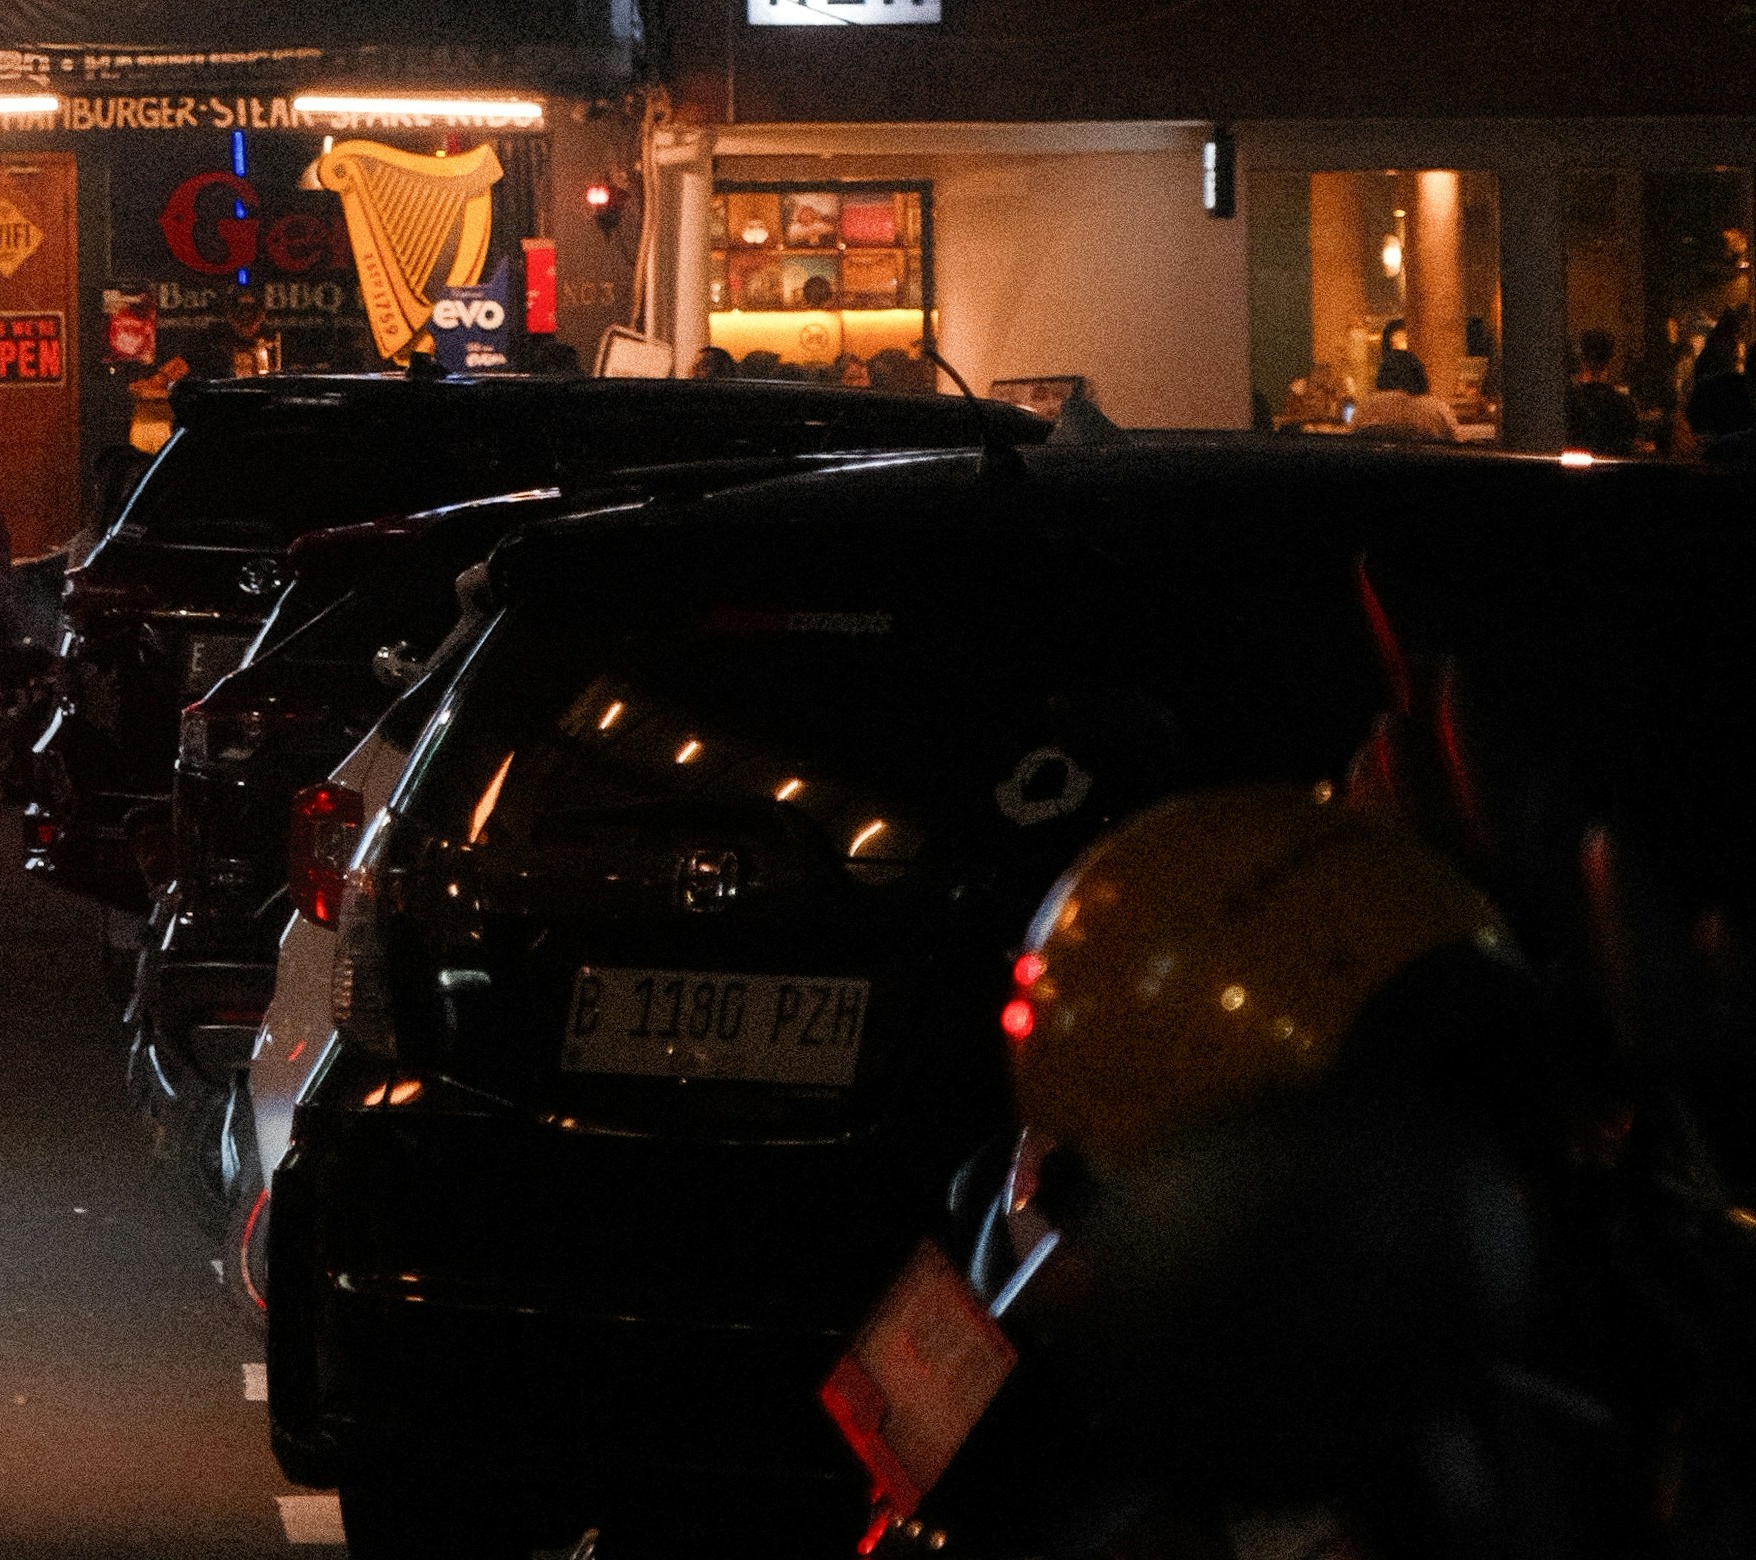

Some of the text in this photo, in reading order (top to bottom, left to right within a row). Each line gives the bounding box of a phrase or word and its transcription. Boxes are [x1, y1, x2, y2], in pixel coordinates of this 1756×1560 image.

[432, 298, 506, 330] evo
[573, 973, 601, 1037] B
[769, 983, 862, 1046] PZH
